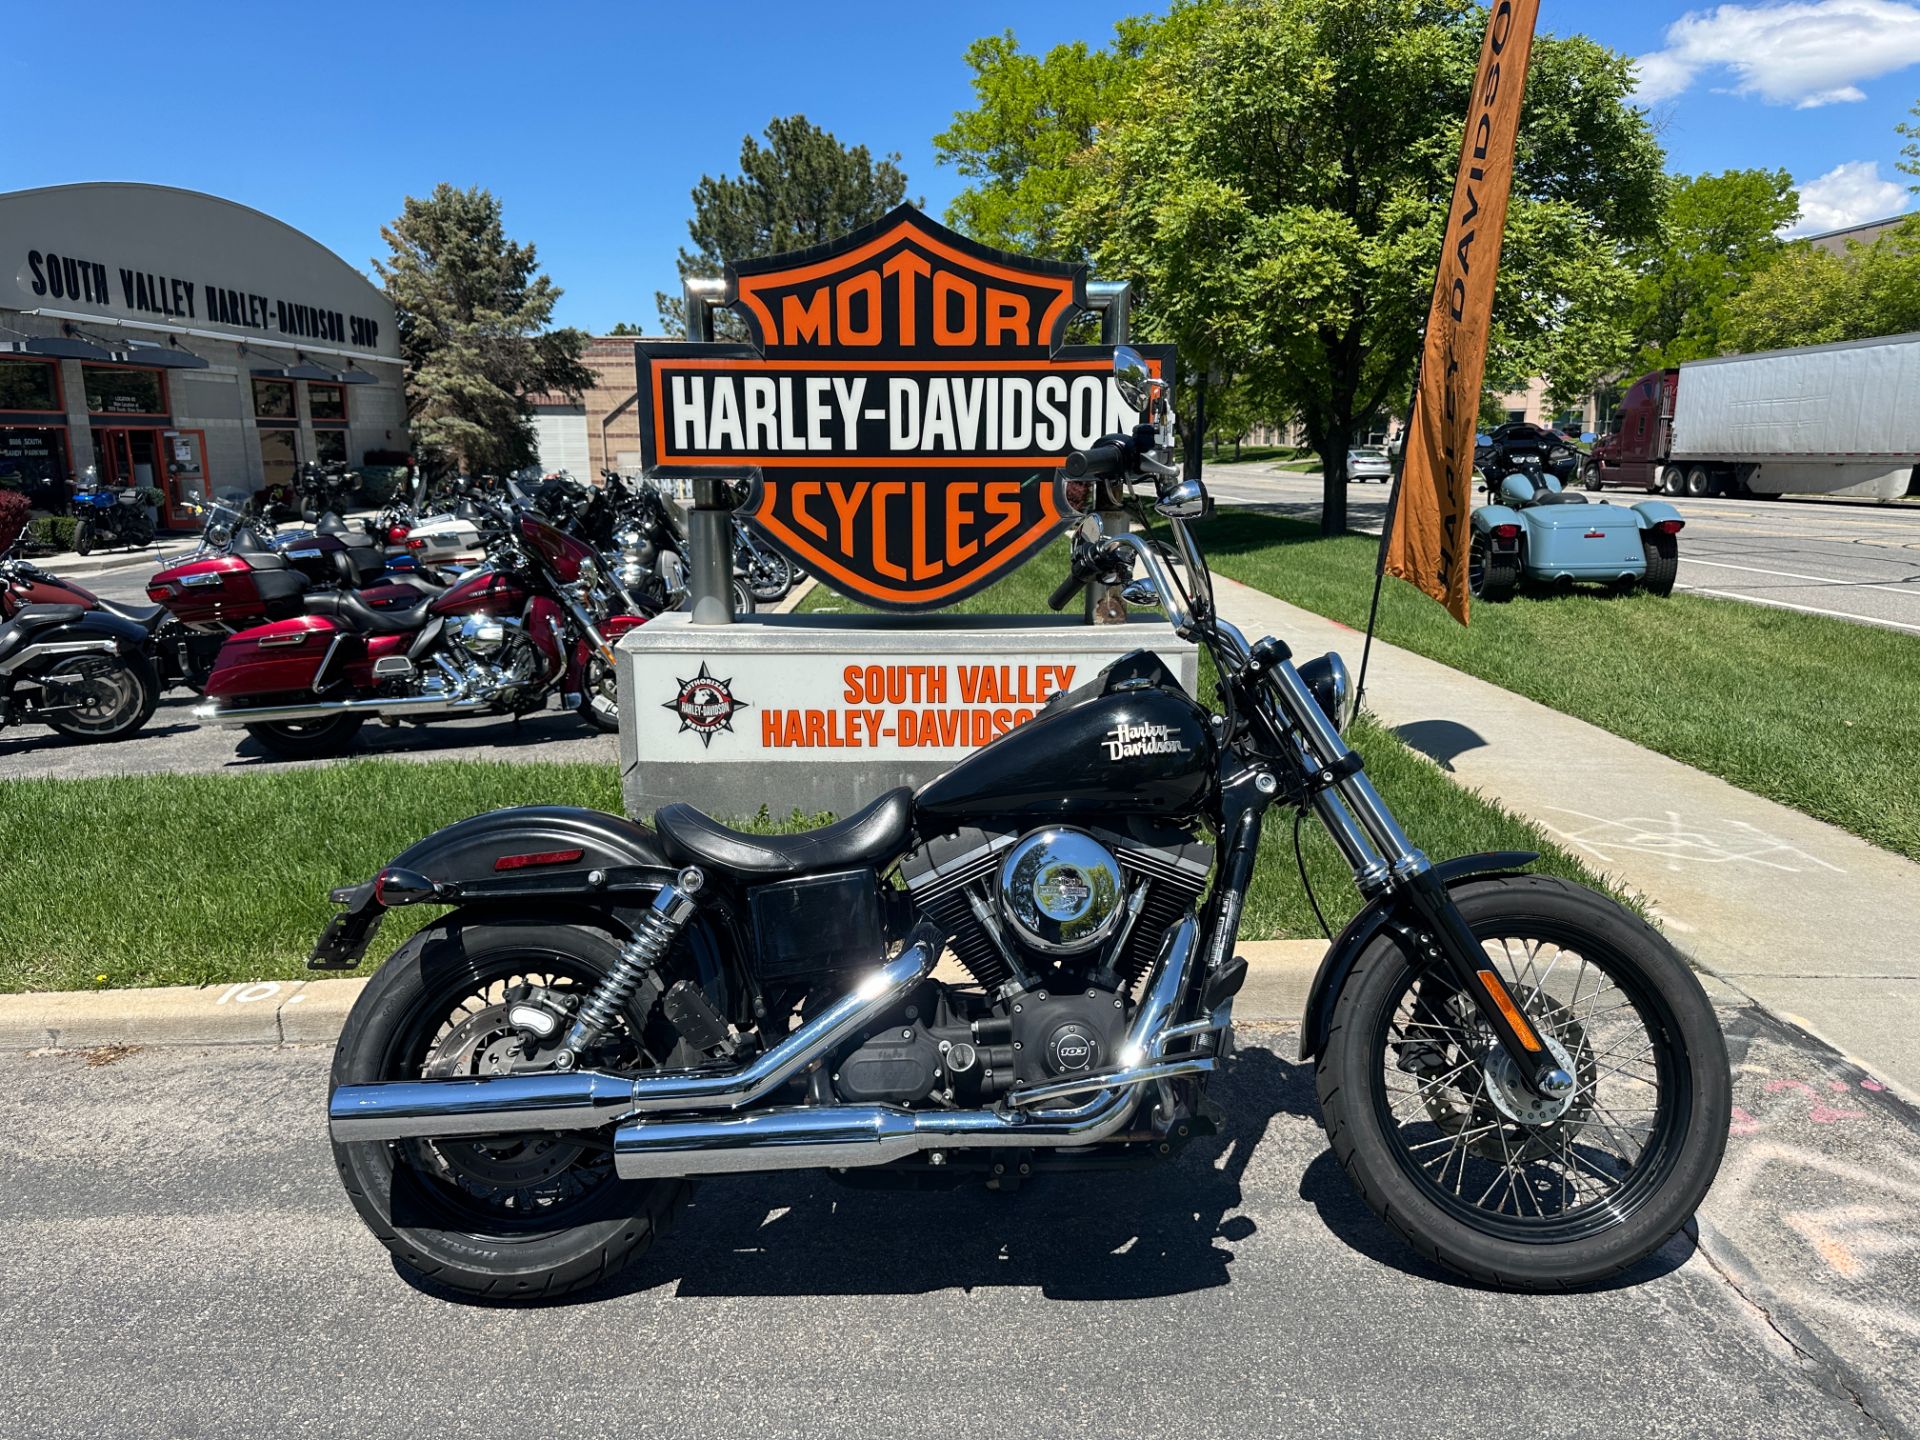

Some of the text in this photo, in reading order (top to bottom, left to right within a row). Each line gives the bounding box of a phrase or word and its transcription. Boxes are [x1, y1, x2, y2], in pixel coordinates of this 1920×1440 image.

[28, 249, 379, 348] SOUTH VALLEY HARLEY-DAVIDSON SHOP
[781, 248, 1031, 347] MOTOR
[671, 375, 1140, 452] HARLEY-DAVIDSON
[791, 481, 1022, 582] CYCLES
[682, 678, 728, 696] AUTHORIZED
[843, 664, 1076, 705] SOUTH VALLEY
[681, 701, 729, 716] HARLEY-DAVIDSON
[685, 718, 727, 732] RENTALS
[761, 708, 1041, 748] HARLEY-DAVIDS
[1107, 721, 1181, 743] Harley
[1101, 736, 1191, 761] Davidson
[1060, 1046, 1088, 1056] 103
